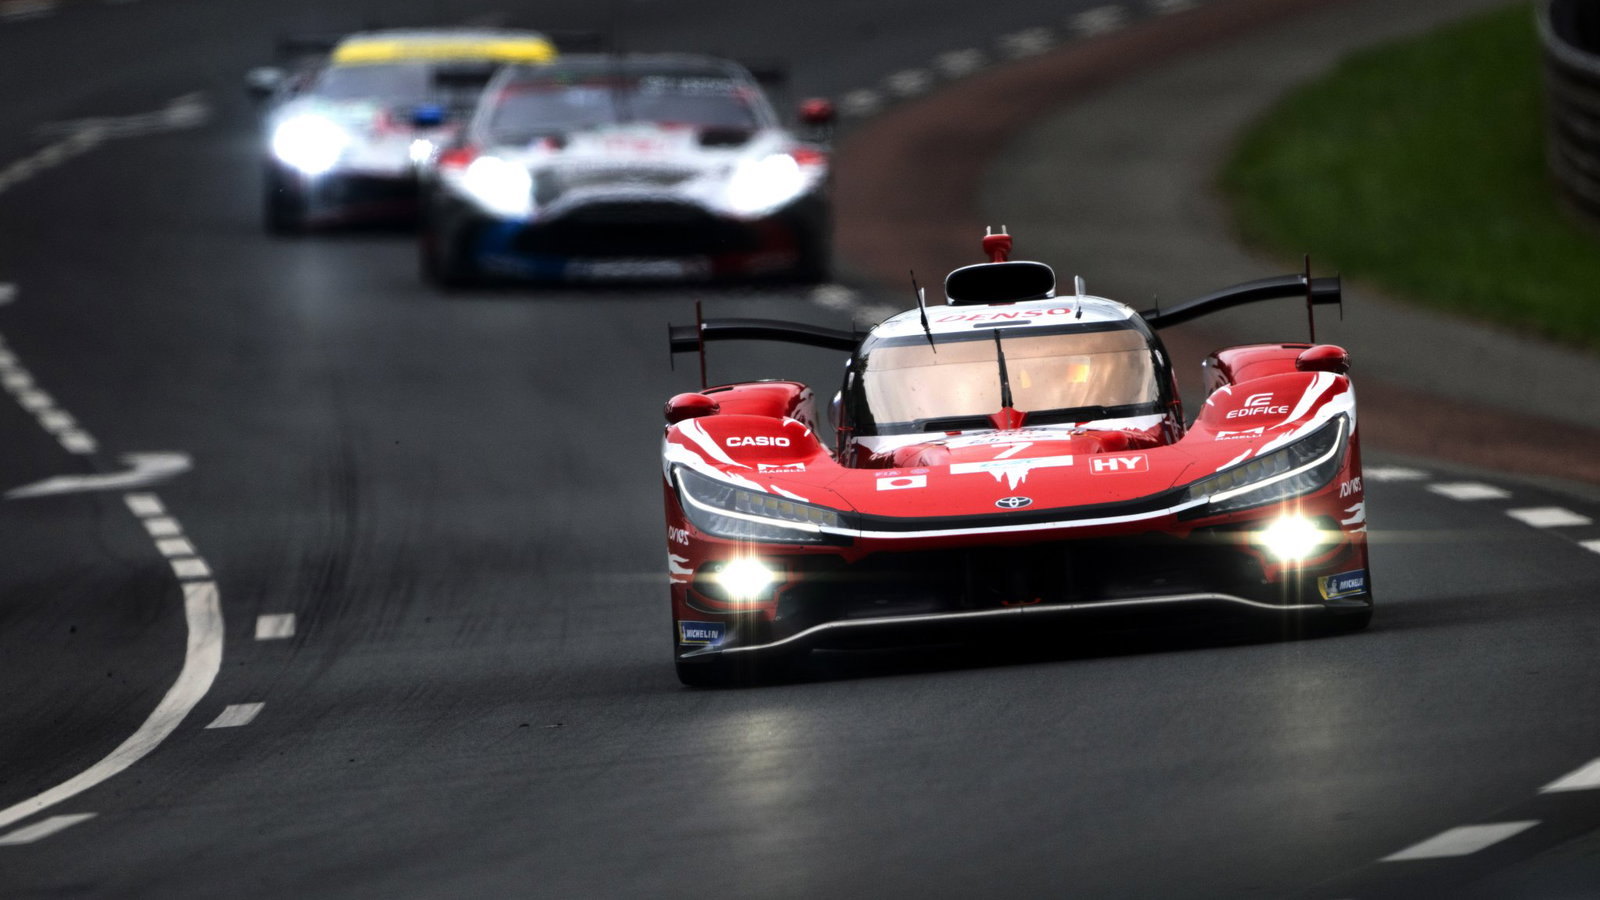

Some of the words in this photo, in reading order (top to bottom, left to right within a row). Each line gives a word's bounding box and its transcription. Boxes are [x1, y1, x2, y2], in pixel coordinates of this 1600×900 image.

[935, 307, 1071, 323] DENSO
[1226, 405, 1289, 419] EDIFICE
[726, 436, 790, 447] CASIO
[1094, 456, 1142, 471] HY
